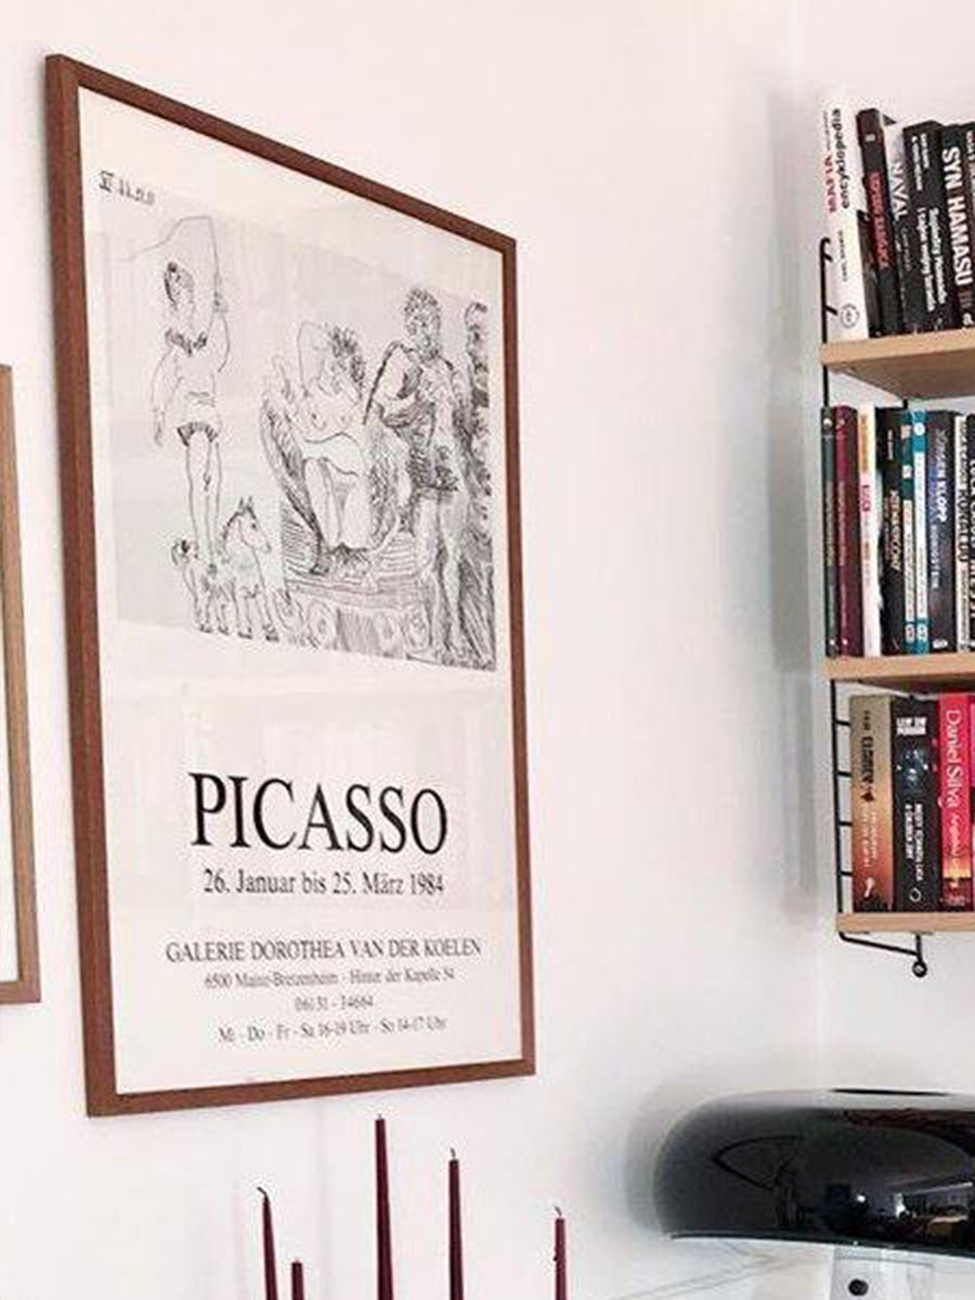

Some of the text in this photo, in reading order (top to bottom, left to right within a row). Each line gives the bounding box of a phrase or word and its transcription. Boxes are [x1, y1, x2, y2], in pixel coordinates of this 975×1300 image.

[831, 107, 851, 210] encyklopedia
[891, 161, 909, 220] NAVAL
[942, 147, 972, 286] SYN HAMASU
[936, 481, 946, 522] KLOPP
[946, 710, 964, 808] Daniel Silva
[189, 771, 448, 855] PICASSO
[203, 868, 444, 896] 26. Januar bis 25. März 1984
[165, 938, 482, 963] GALERIE DOROTHEA VAN DER KOELEN
[204, 974, 233, 990] 6500
[247, 1026, 265, 1042] Do
